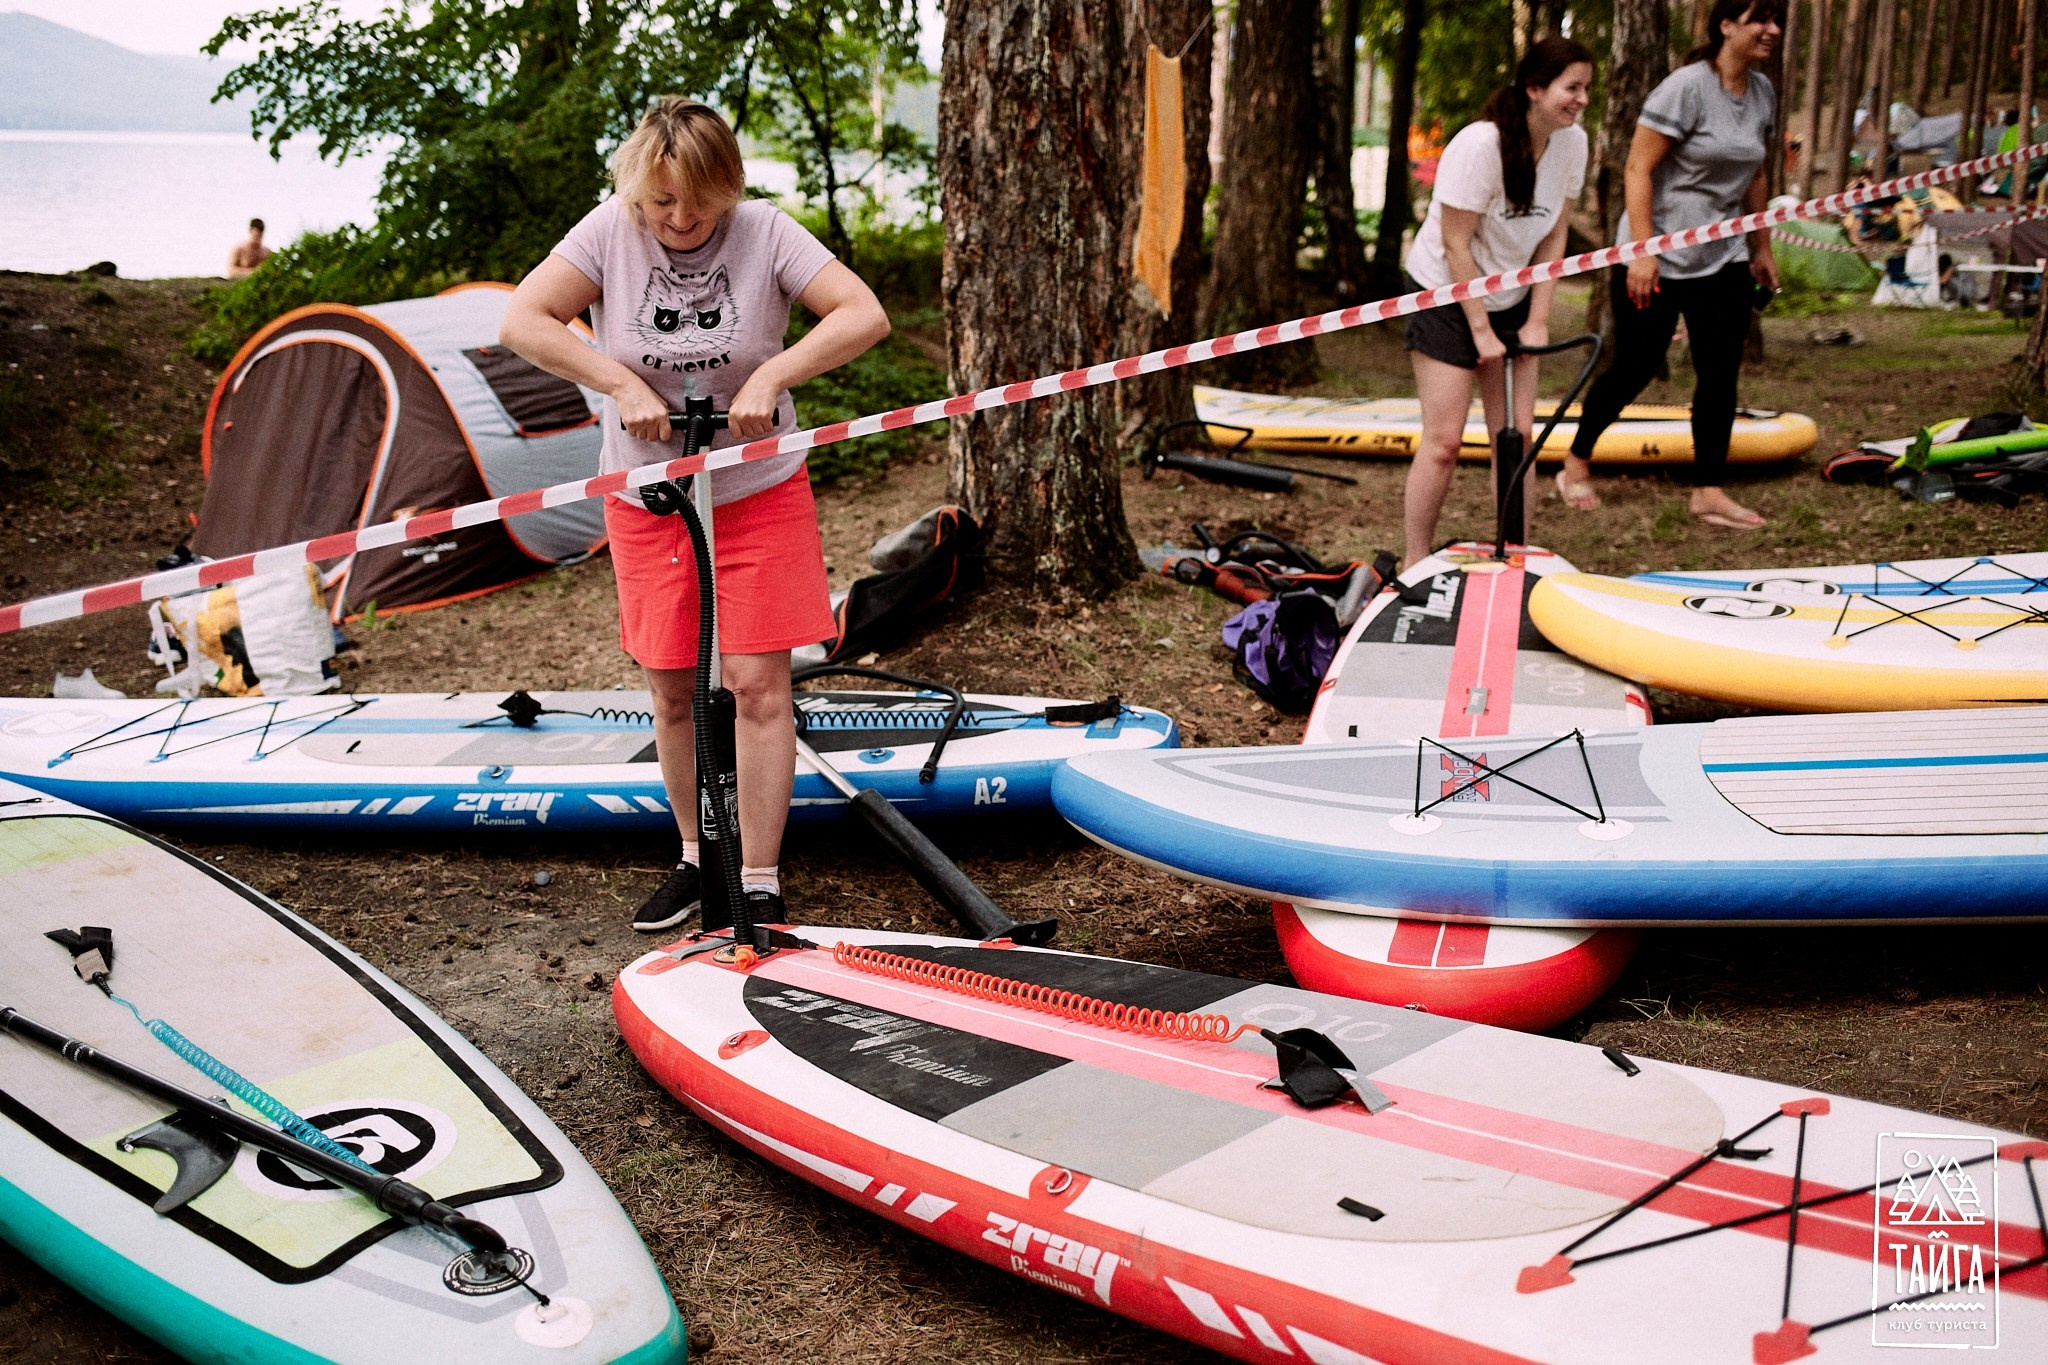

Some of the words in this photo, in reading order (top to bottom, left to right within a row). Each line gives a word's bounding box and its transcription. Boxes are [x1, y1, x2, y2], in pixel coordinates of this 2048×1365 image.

[672, 350, 731, 373] Never
[974, 776, 1008, 805] A2
[473, 812, 528, 826] Premium
[1010, 1253, 1086, 1298] Premium
